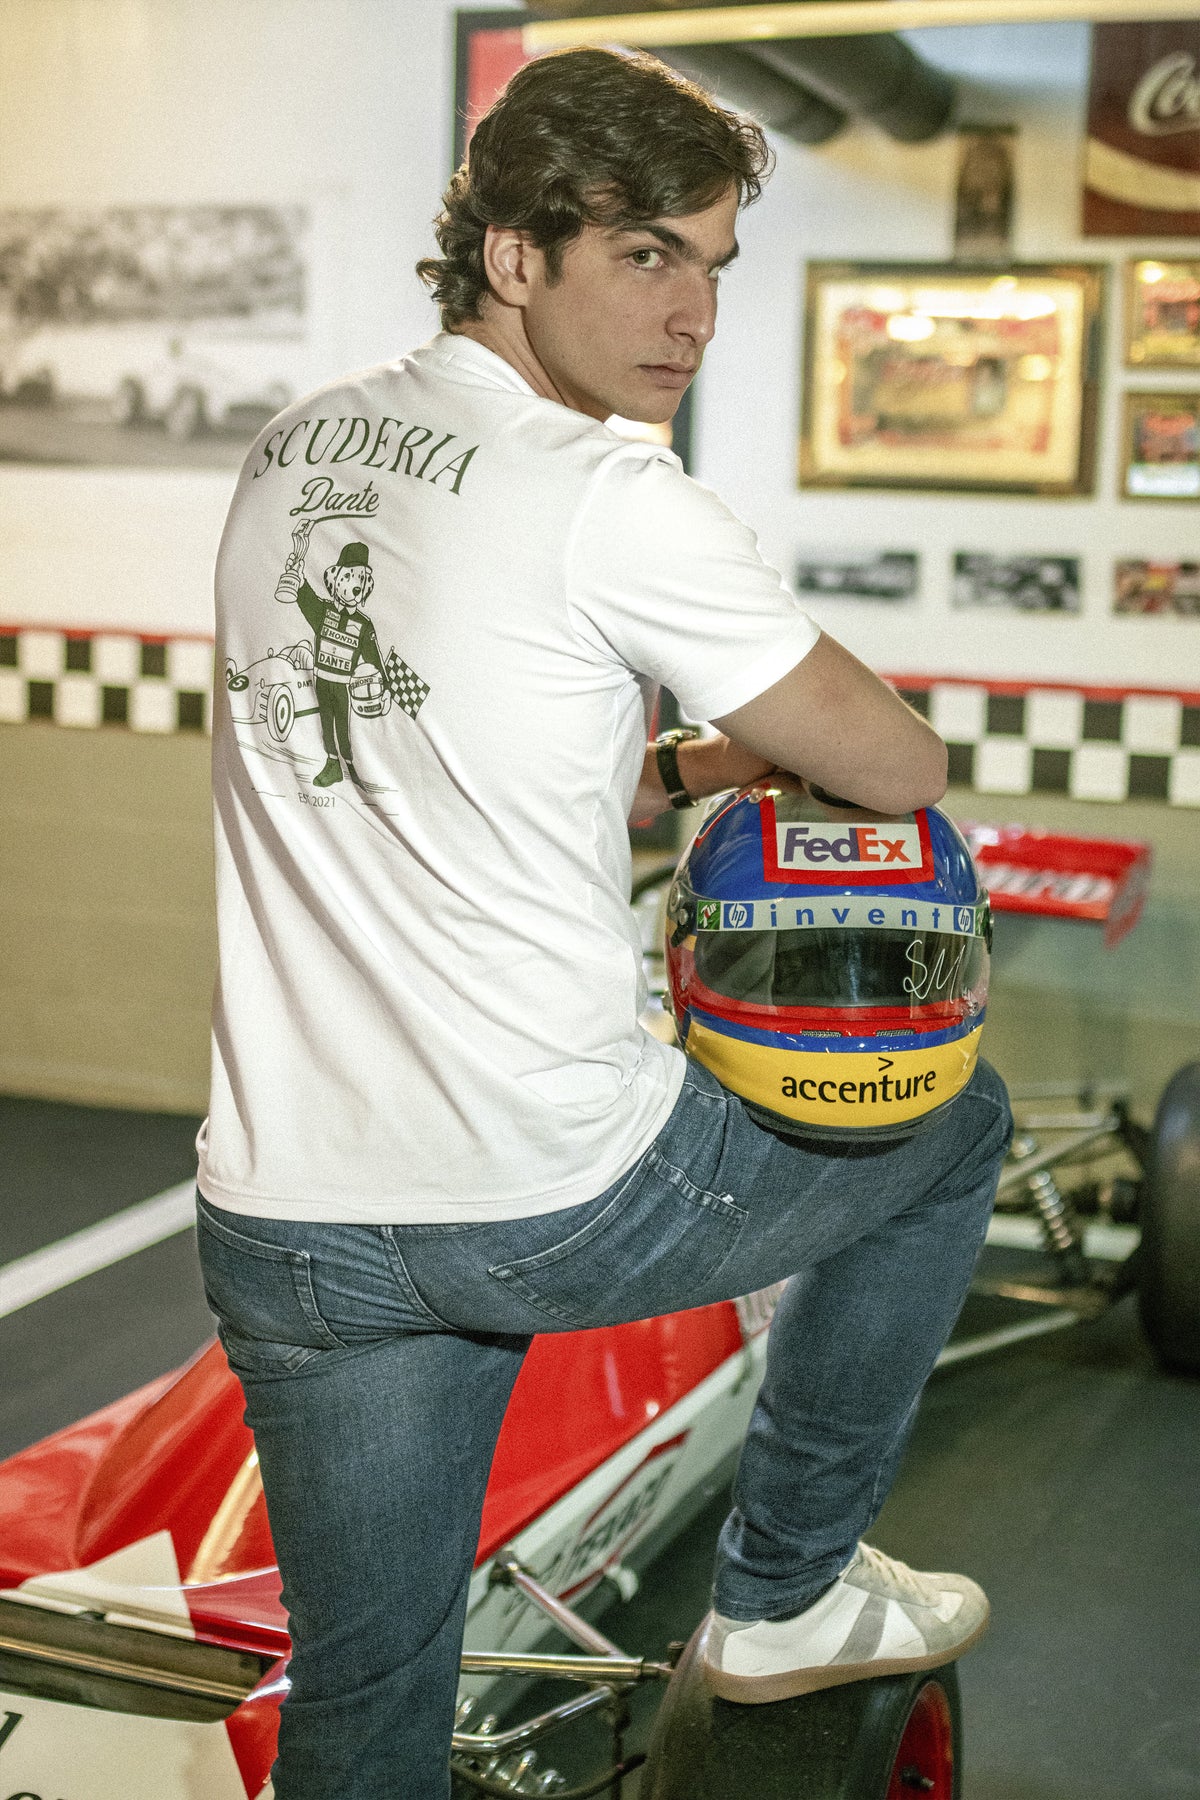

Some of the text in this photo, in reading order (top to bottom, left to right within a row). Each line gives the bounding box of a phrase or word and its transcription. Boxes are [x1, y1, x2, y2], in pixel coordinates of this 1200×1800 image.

[252, 417, 480, 496] SCUDERIA
[289, 477, 379, 517] Dante
[319, 653, 350, 670] DANTE
[312, 795, 335, 808] 2021
[783, 827, 911, 863] FedEx
[770, 903, 940, 929] invent
[781, 1070, 937, 1104] accenture
